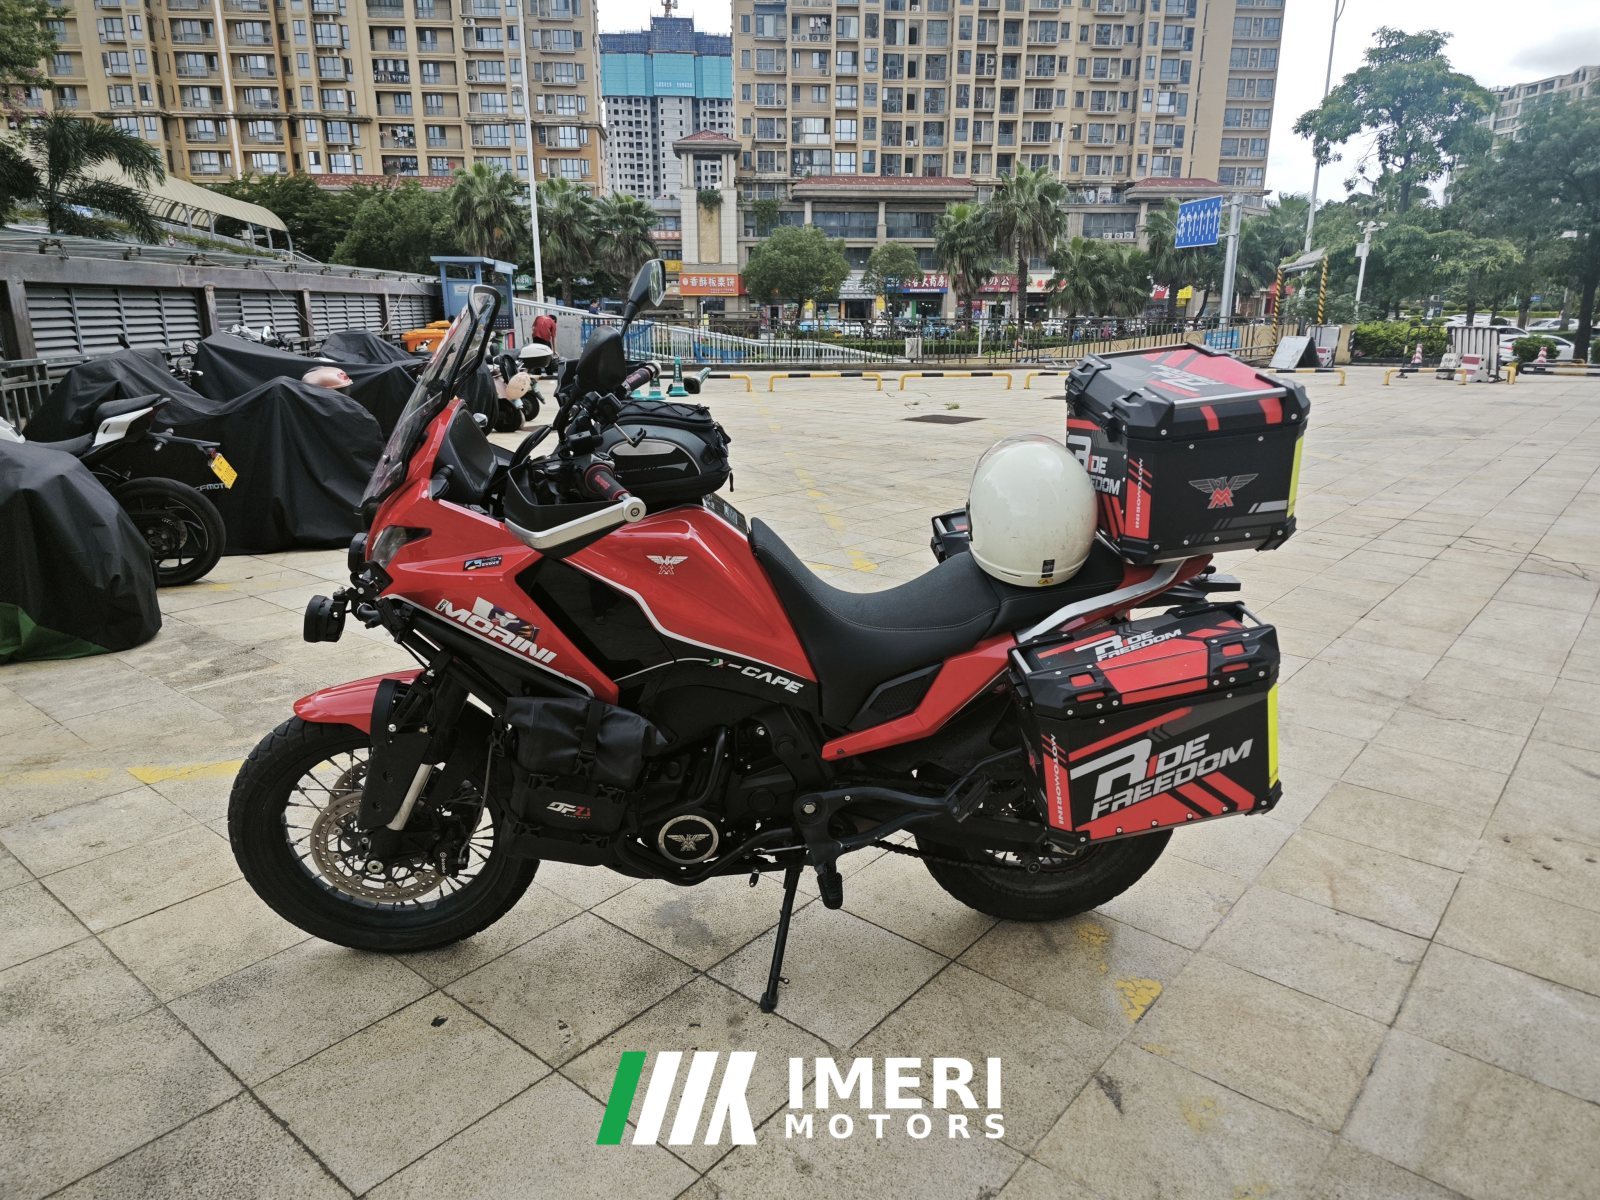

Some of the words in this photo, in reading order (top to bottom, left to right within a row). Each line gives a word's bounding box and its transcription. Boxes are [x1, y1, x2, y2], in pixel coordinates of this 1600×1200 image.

[441, 601, 558, 664] MORINI
[1074, 630, 1155, 656] RIDE
[1096, 628, 1183, 662] FREEDOM
[1070, 733, 1210, 800] RIDE
[1090, 738, 1254, 822] FREEDOM
